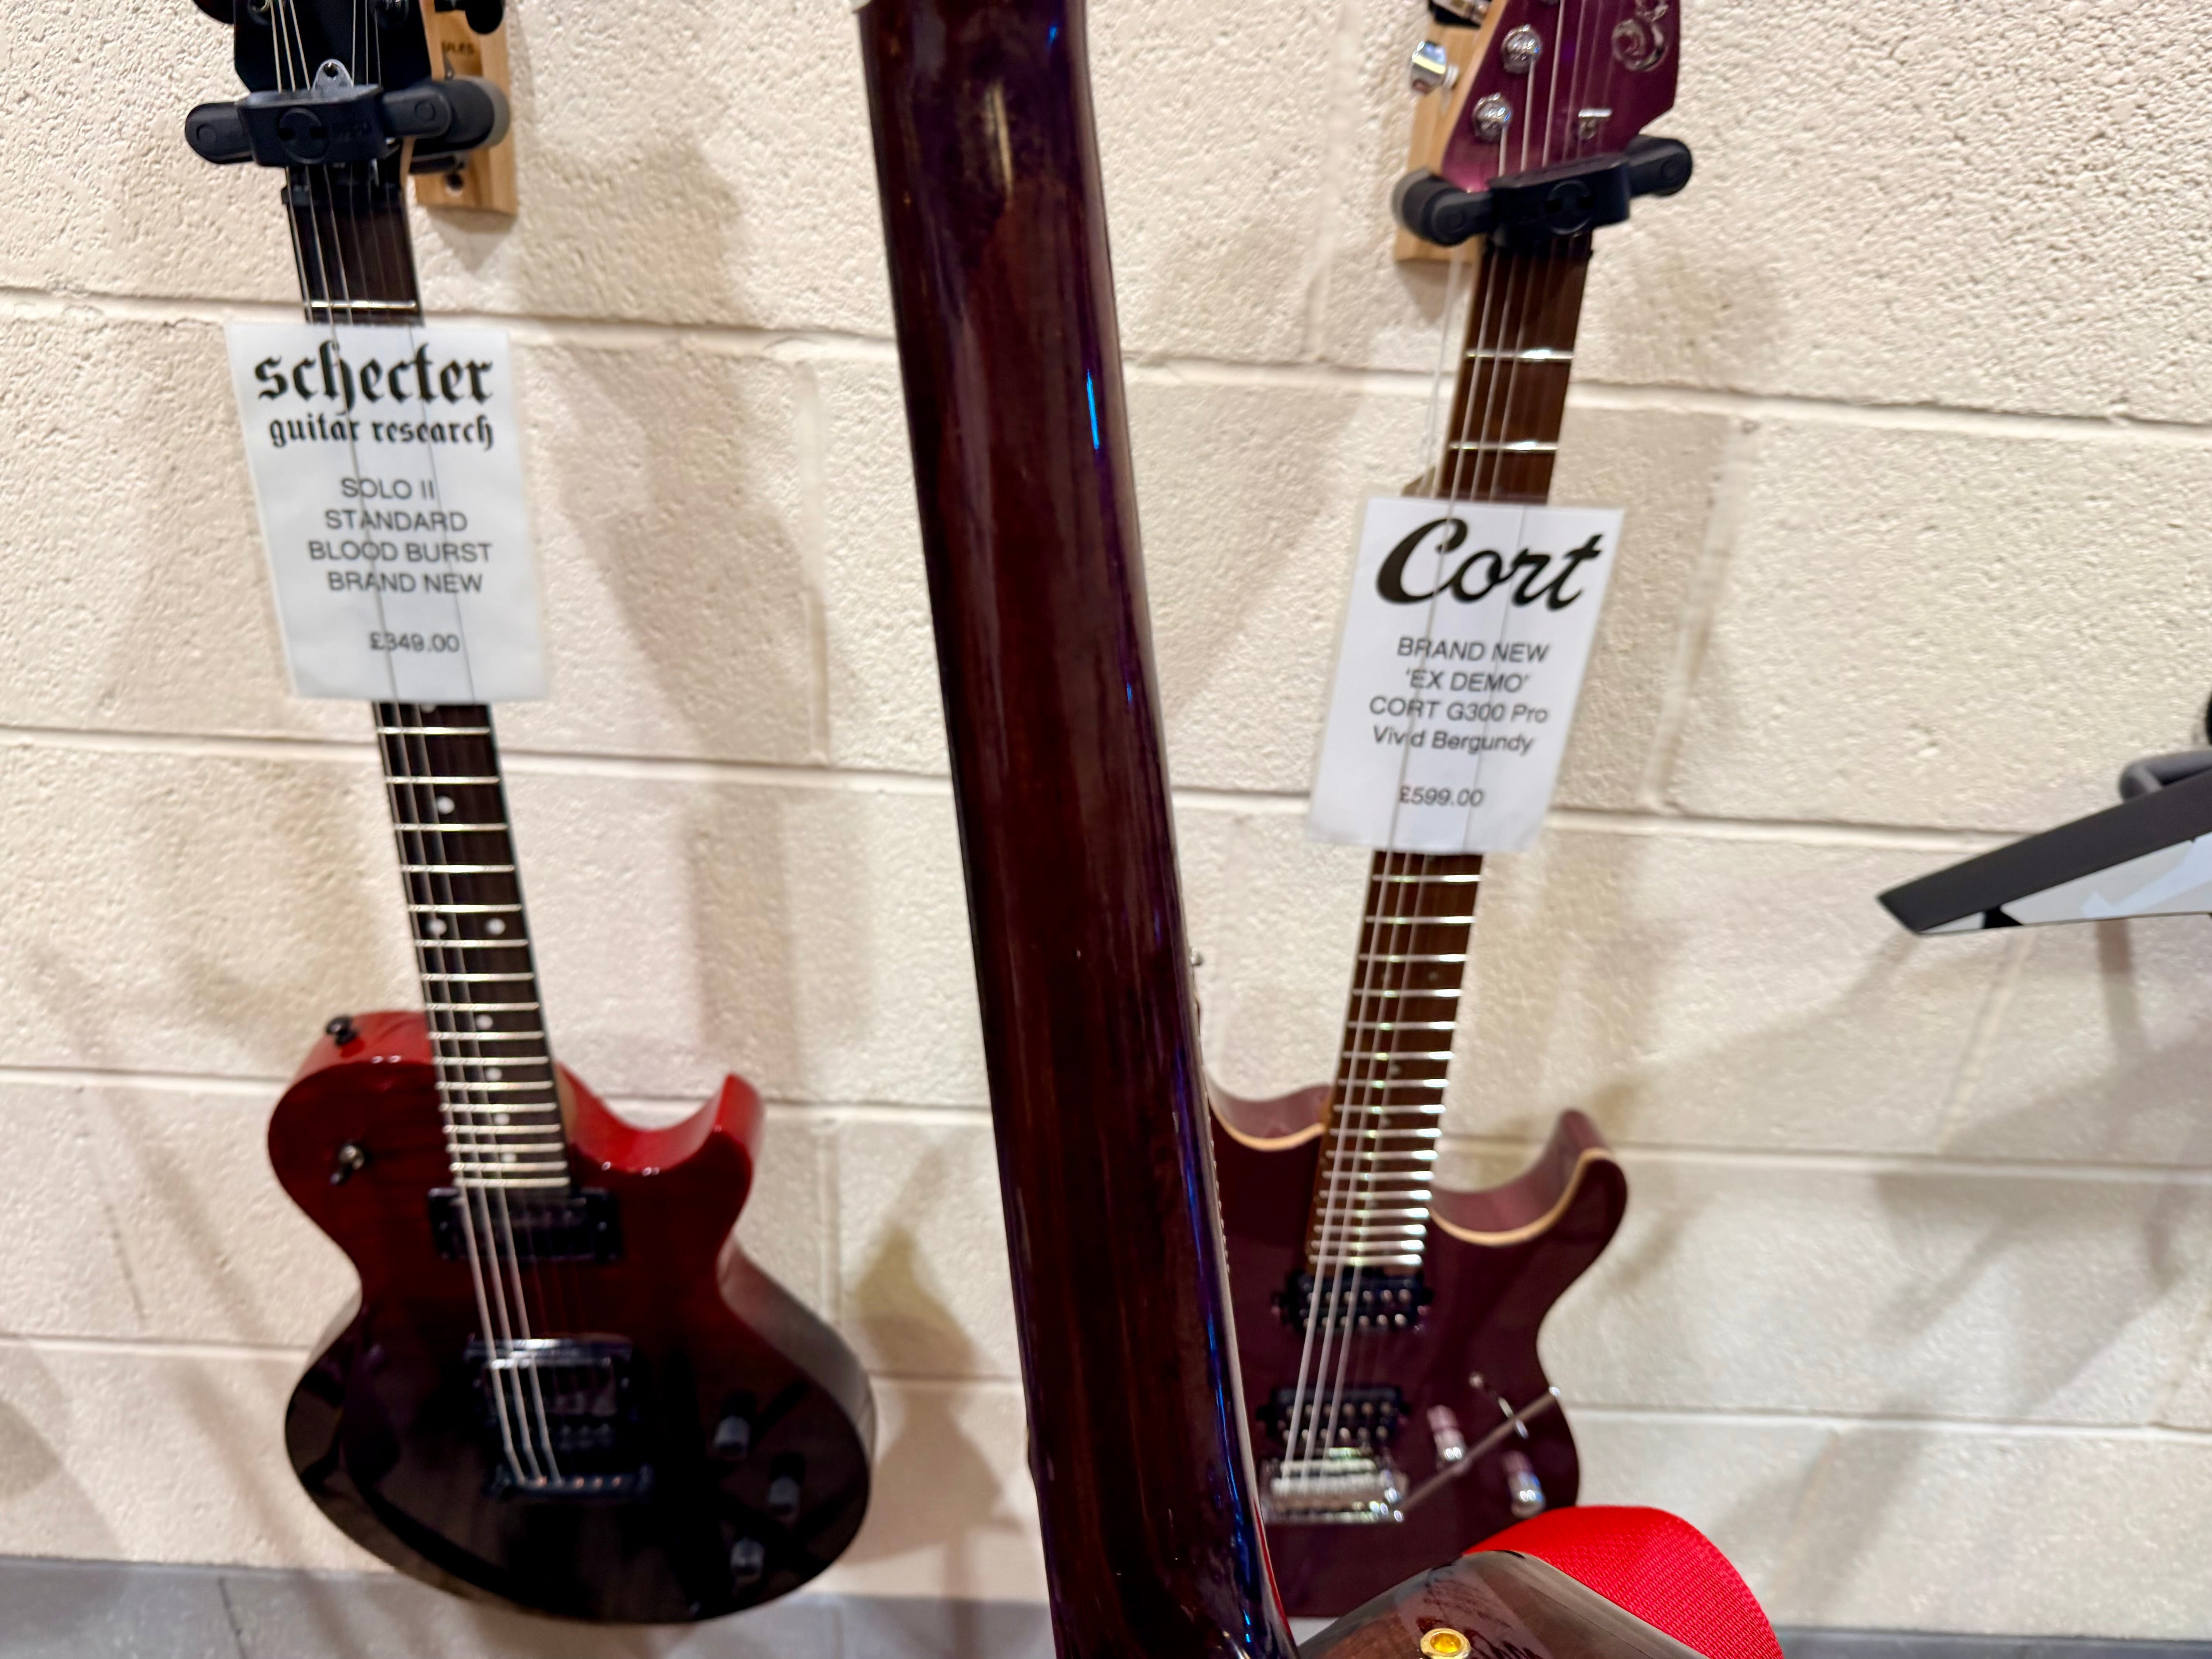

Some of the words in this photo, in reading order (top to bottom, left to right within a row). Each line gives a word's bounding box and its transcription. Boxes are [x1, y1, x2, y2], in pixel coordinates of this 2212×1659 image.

[254, 340, 493, 415] schecter
[270, 412, 361, 448] guitar
[372, 415, 494, 451] research
[341, 477, 412, 500] SOLO
[421, 480, 434, 500] II
[325, 509, 467, 531] STANDARD
[309, 541, 398, 561] BLOOD
[406, 543, 492, 563] BURST
[1376, 518, 1604, 611] Cort
[327, 572, 416, 592] BRAND
[423, 574, 483, 593] NEW
[370, 632, 460, 653] £349.00
[1398, 637, 1486, 661] BRAND
[1491, 643, 1549, 662] NEW
[1369, 696, 1441, 718] CORT
[1446, 702, 1505, 722] G300
[1511, 704, 1548, 723] Pro
[1374, 725, 1425, 747] Vivd
[1432, 730, 1534, 756] Bergundy
[1400, 786, 1484, 807] £599.00
